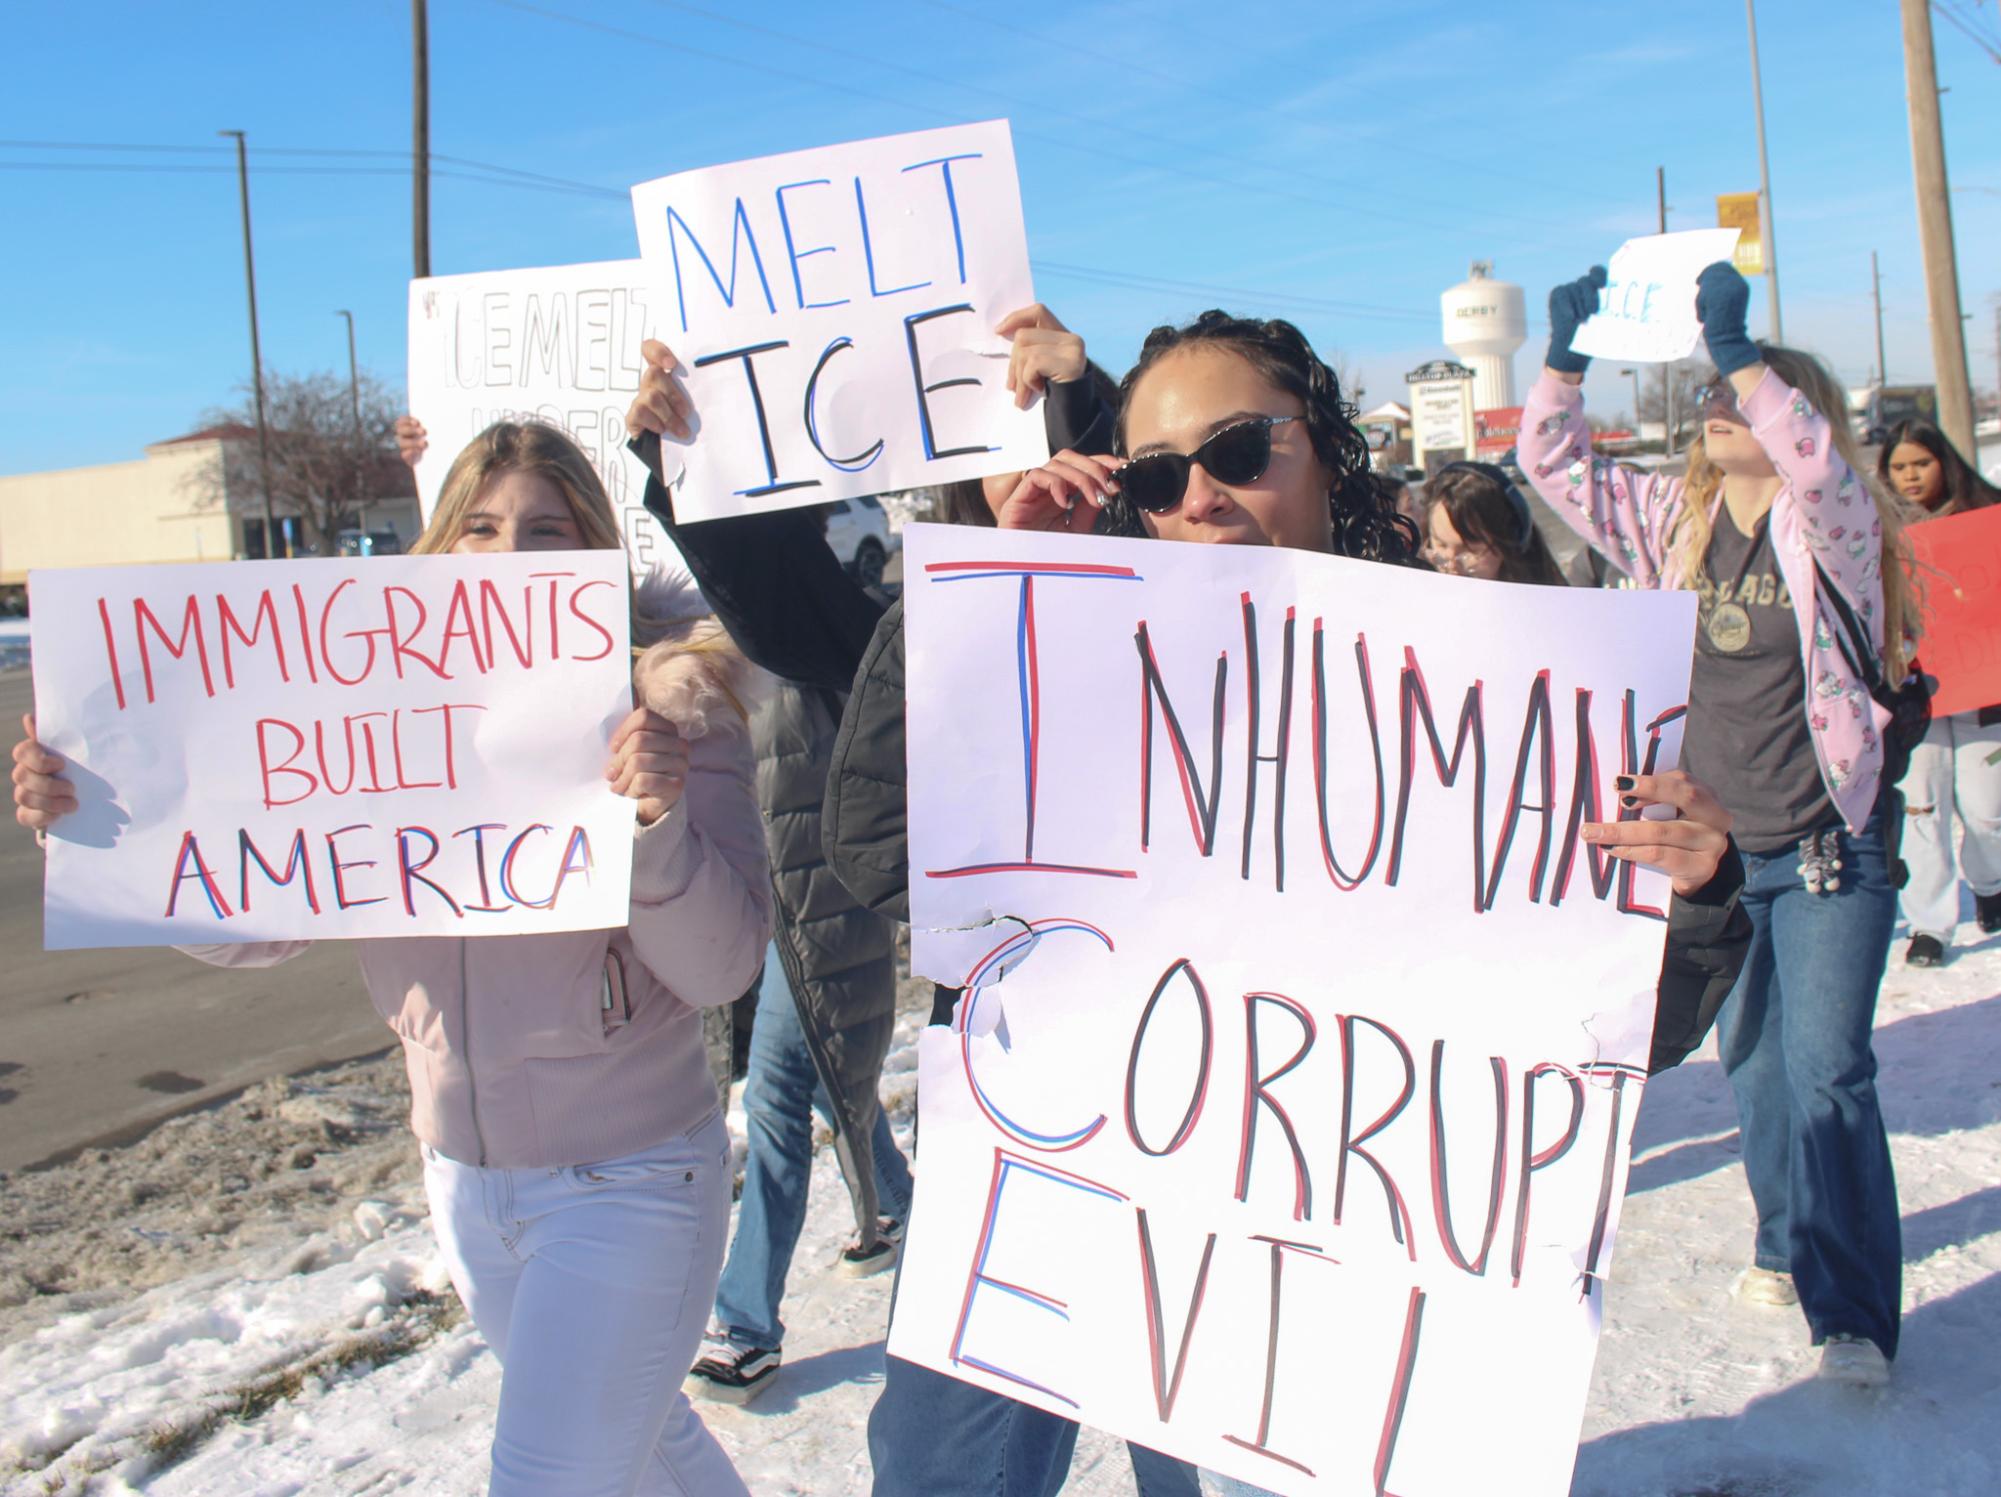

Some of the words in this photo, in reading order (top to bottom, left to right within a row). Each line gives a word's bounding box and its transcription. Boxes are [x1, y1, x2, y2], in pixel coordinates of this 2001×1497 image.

[666, 153, 983, 332] MELT
[1456, 304, 1498, 318] DERBY
[694, 303, 1001, 497] ICE
[97, 571, 619, 710] IMMIGRANTS
[256, 704, 488, 811] BUILT
[165, 823, 596, 920] AMERICA
[960, 916, 1648, 1303] CORRUPT
